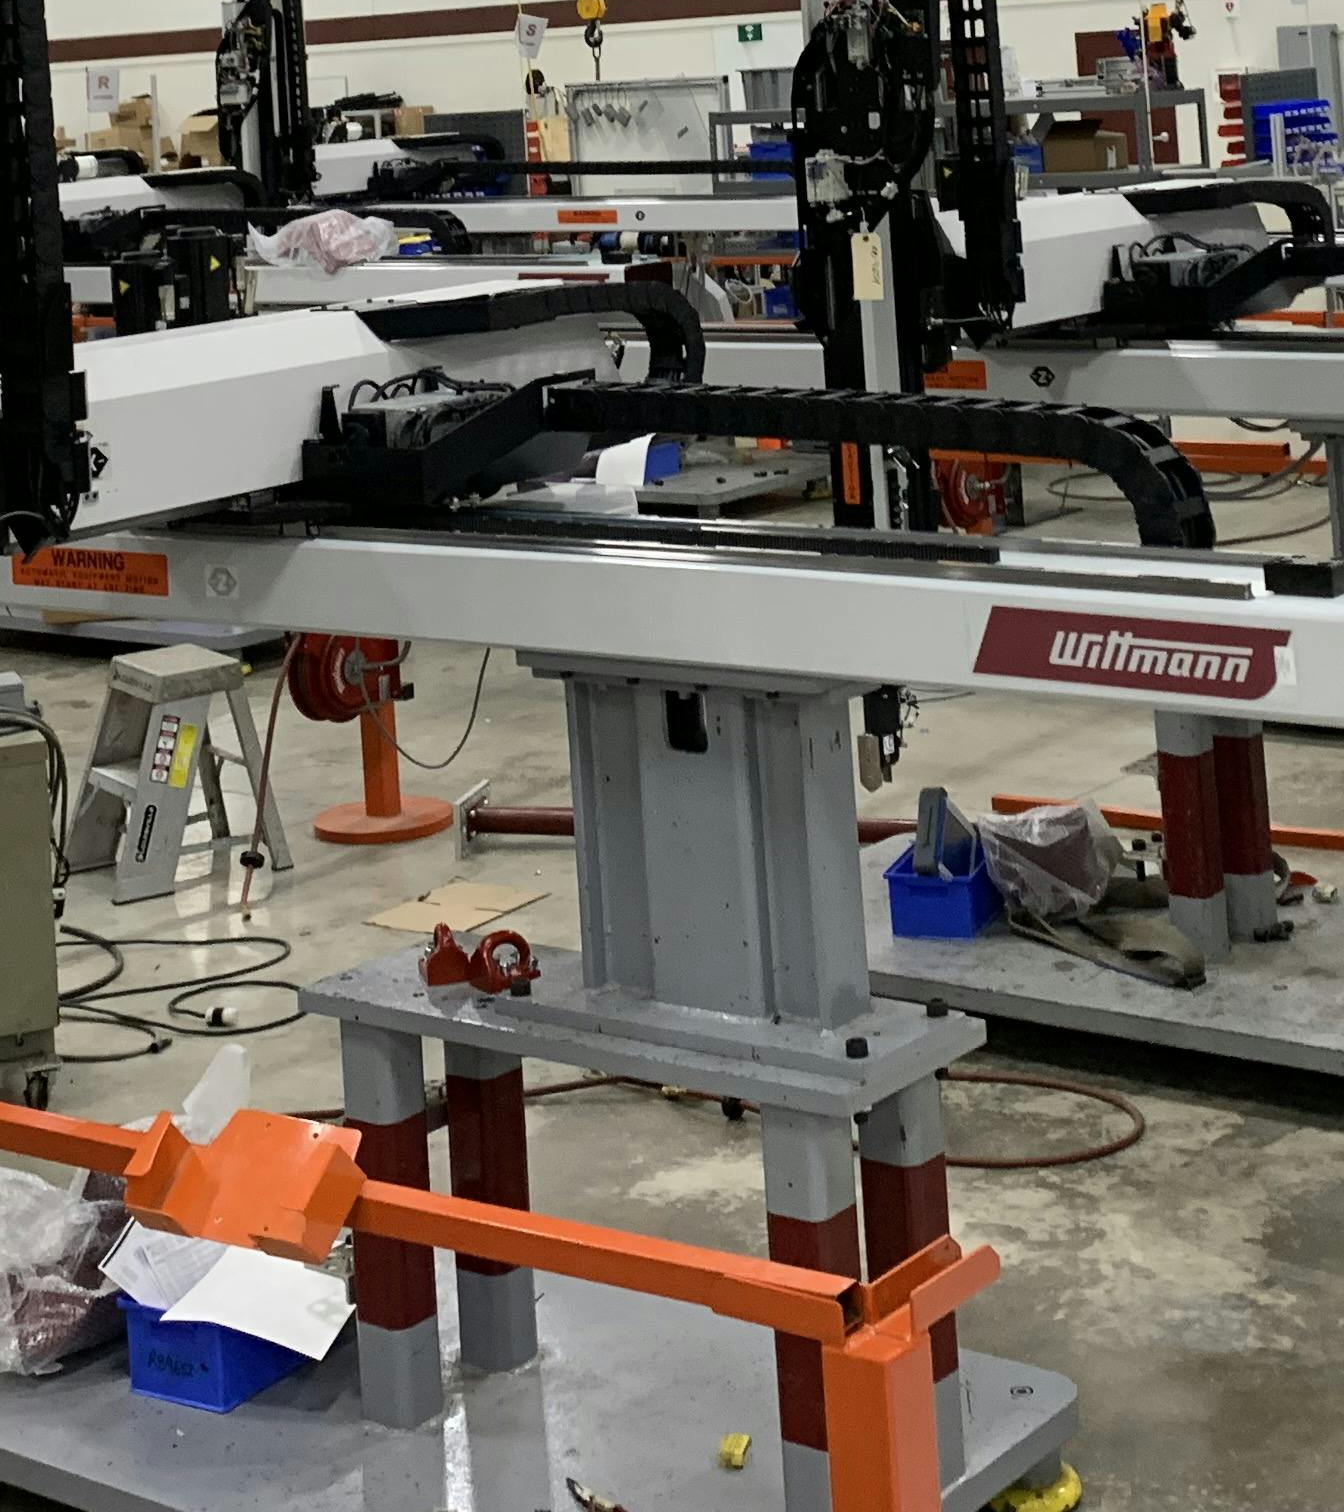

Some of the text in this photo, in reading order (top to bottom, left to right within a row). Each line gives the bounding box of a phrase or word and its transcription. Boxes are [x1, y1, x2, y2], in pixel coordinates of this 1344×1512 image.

[526, 23, 537, 37] S
[98, 75, 110, 89] R
[51, 549, 125, 572] WARNING
